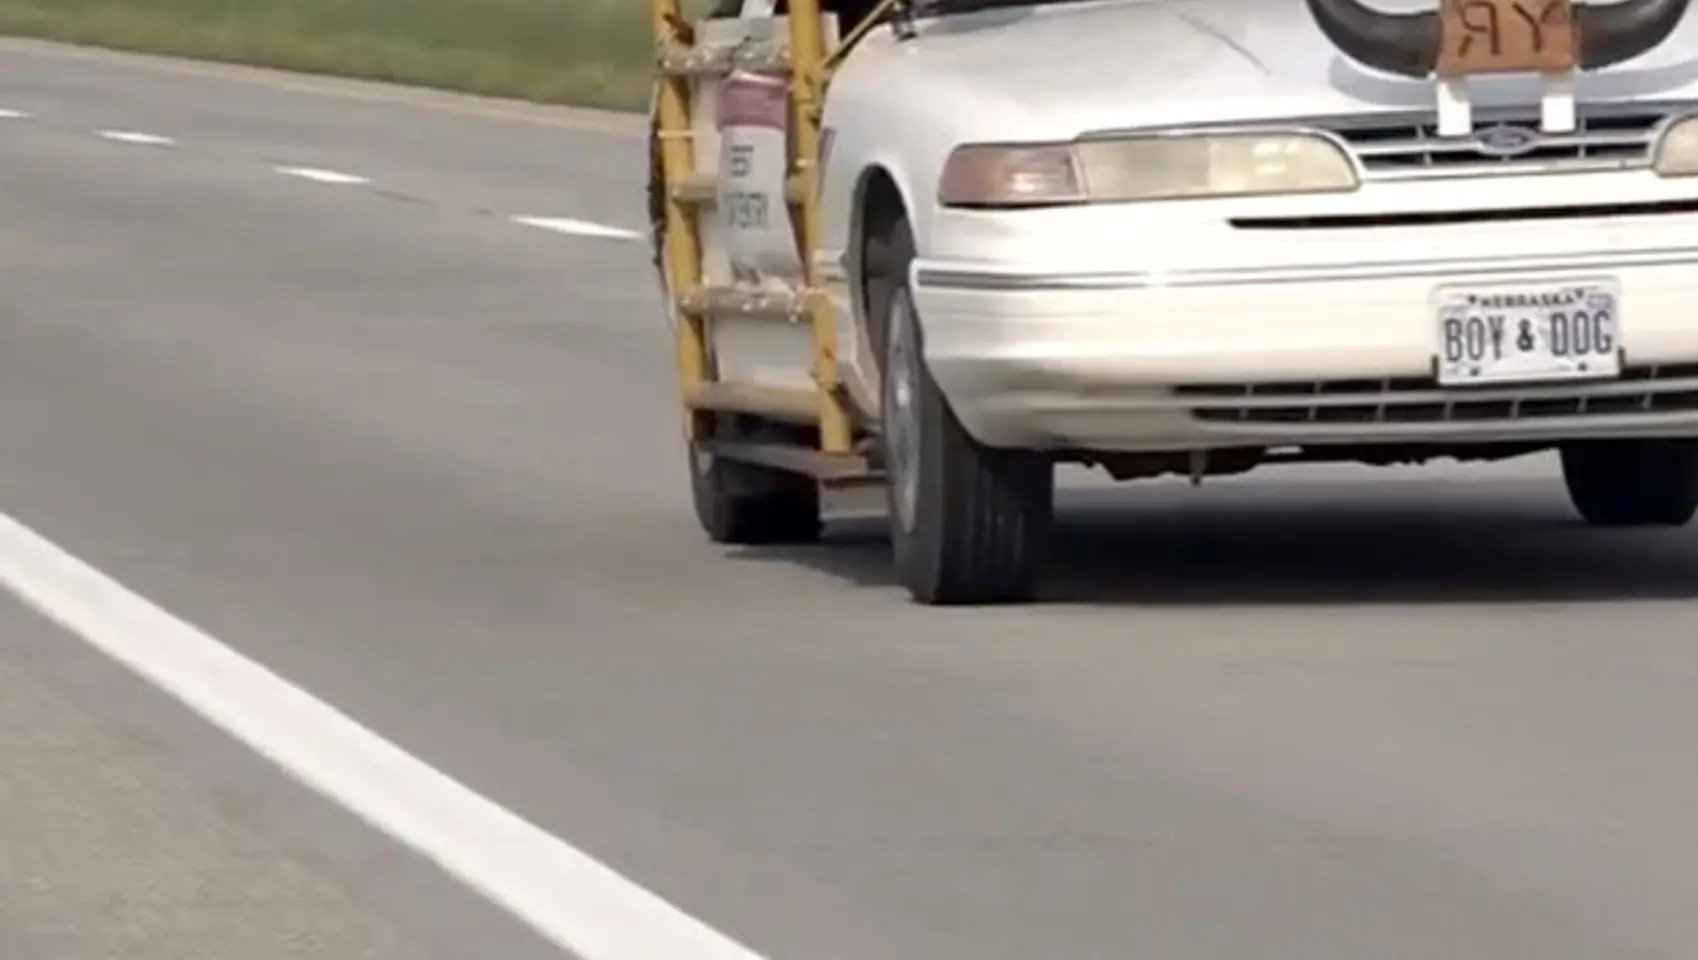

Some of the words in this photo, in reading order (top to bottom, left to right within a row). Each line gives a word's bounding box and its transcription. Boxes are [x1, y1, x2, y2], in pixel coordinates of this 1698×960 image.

[1480, 292, 1575, 309] NEBRASKA
[1444, 314, 1505, 363] BOY
[1516, 318, 1535, 352] &
[1550, 310, 1612, 357] DOG
